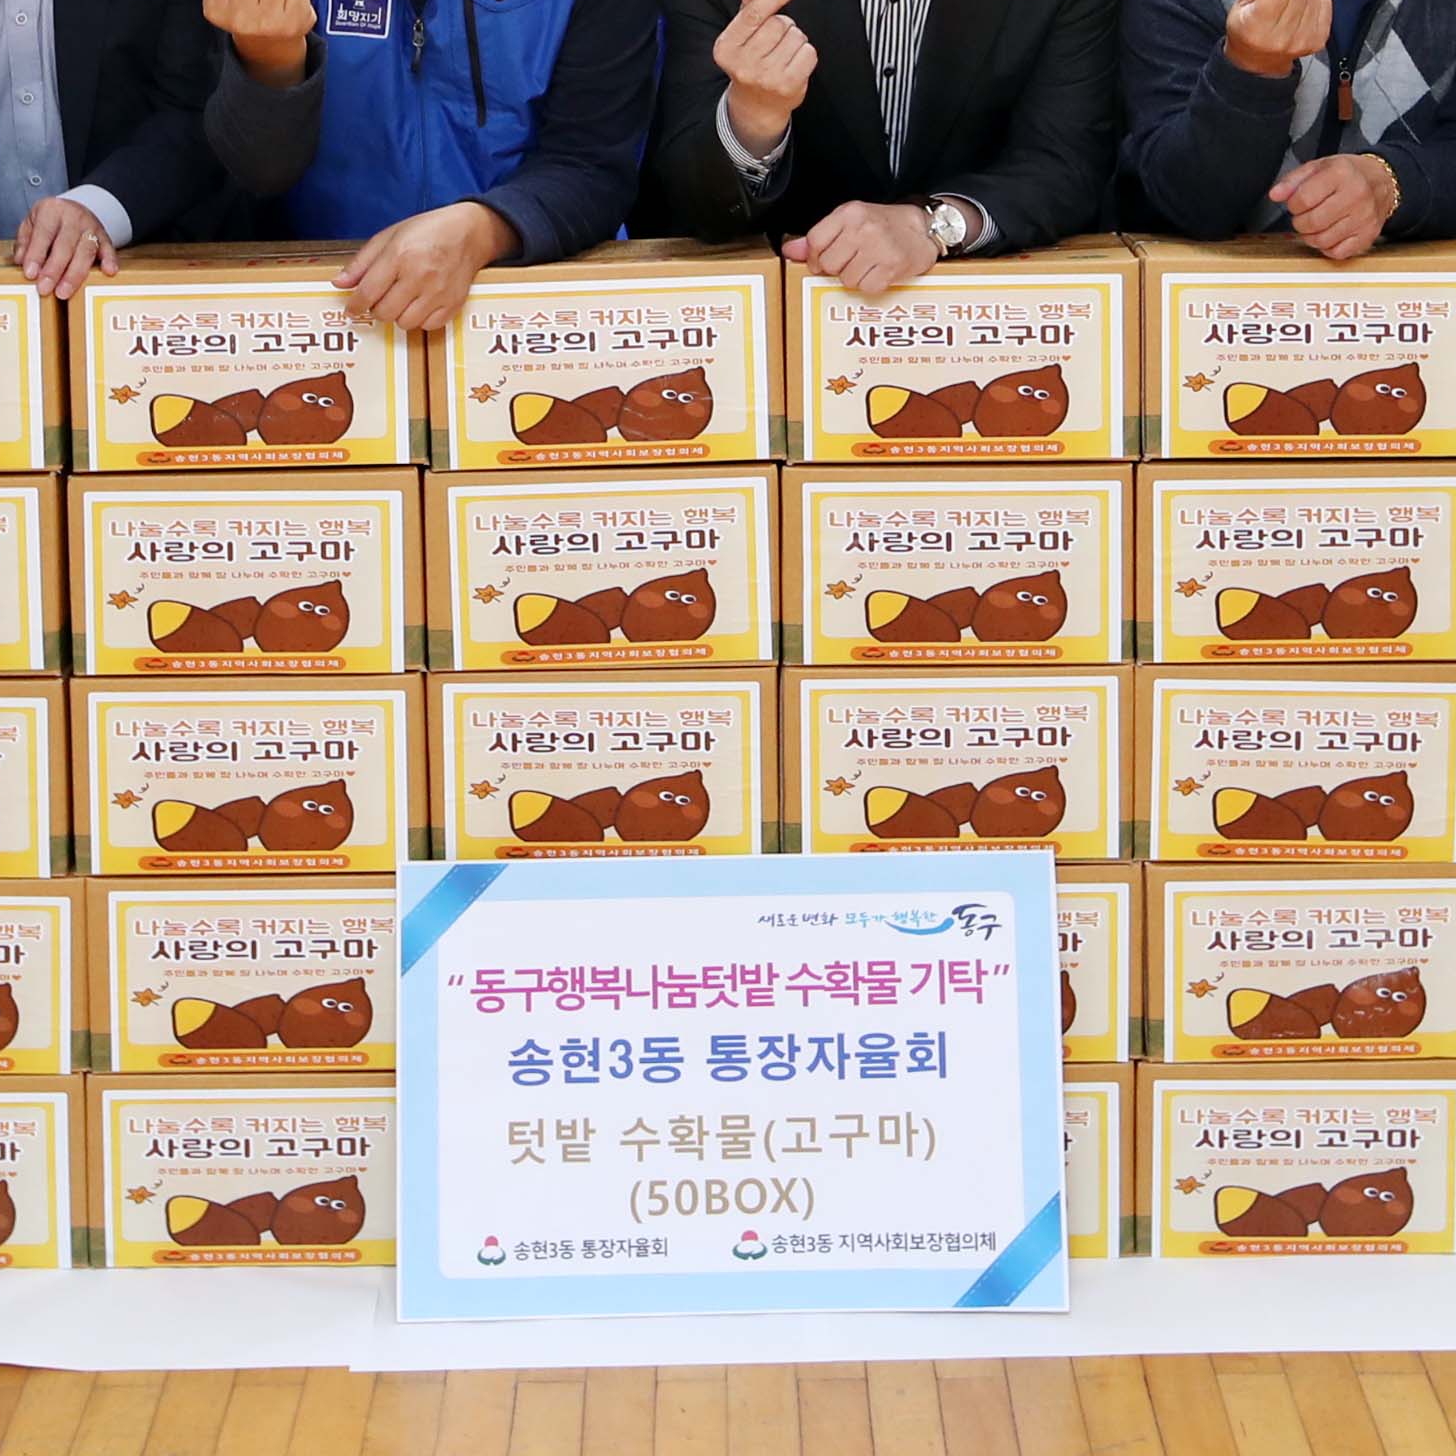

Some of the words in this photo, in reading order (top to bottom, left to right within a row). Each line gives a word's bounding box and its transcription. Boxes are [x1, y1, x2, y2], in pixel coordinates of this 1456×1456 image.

[337, 3, 382, 25] 희망지기
[1189, 302, 1295, 319] 나눌수록
[1307, 302, 1385, 319] 커지는
[1397, 302, 1449, 318] 행복
[128, 333, 237, 356] 사랑의
[252, 331, 359, 354] 고구마
[488, 331, 596, 355] 사랑의
[611, 326, 718, 351] 고구마
[846, 325, 954, 347] 사랑의
[969, 324, 1075, 346] 고구마
[1204, 323, 1312, 344] 사랑의
[1327, 322, 1433, 343] 고구마
[491, 532, 600, 556] 사랑의
[614, 528, 721, 552] 고구마
[845, 531, 953, 552] 사랑의
[968, 531, 1074, 551] 고구마
[1196, 528, 1303, 550] 사랑의
[1318, 527, 1424, 548] 고구마
[127, 541, 234, 562] 사랑의
[249, 540, 355, 561] 고구마
[488, 732, 595, 752] 사랑의
[610, 731, 715, 752] 고구마
[844, 727, 951, 749] 사랑의
[966, 726, 1072, 747] 고구마
[1194, 729, 1302, 751] 사랑의
[1317, 730, 1422, 753] 고구마
[131, 741, 238, 762] 사랑의
[253, 740, 359, 761] 고구마
[801, 911, 838, 926] 변화
[952, 903, 1003, 941] 동구
[151, 939, 258, 960] 사랑의
[273, 938, 378, 959] 고구마
[1207, 929, 1313, 951] 사랑의
[1329, 928, 1433, 949] 고구마
[785, 960, 902, 1007] 수확물
[508, 1037, 684, 1086] 송현3동
[706, 1031, 946, 1082] 통장자율회
[145, 1138, 251, 1158] 사랑의
[266, 1137, 371, 1157] 고구마
[509, 1118, 595, 1164] 텃밭
[620, 1112, 935, 1162] 수확물(고구마)
[1195, 1128, 1301, 1149] 사랑의
[1317, 1128, 1421, 1149] 고구마
[631, 1178, 813, 1223] (50BOX)
[513, 1240, 576, 1261] 송현3동
[580, 1237, 669, 1259] 통장자율회
[771, 1234, 833, 1255] 송현3동
[838, 1231, 997, 1253] 지역사회보장협의체
